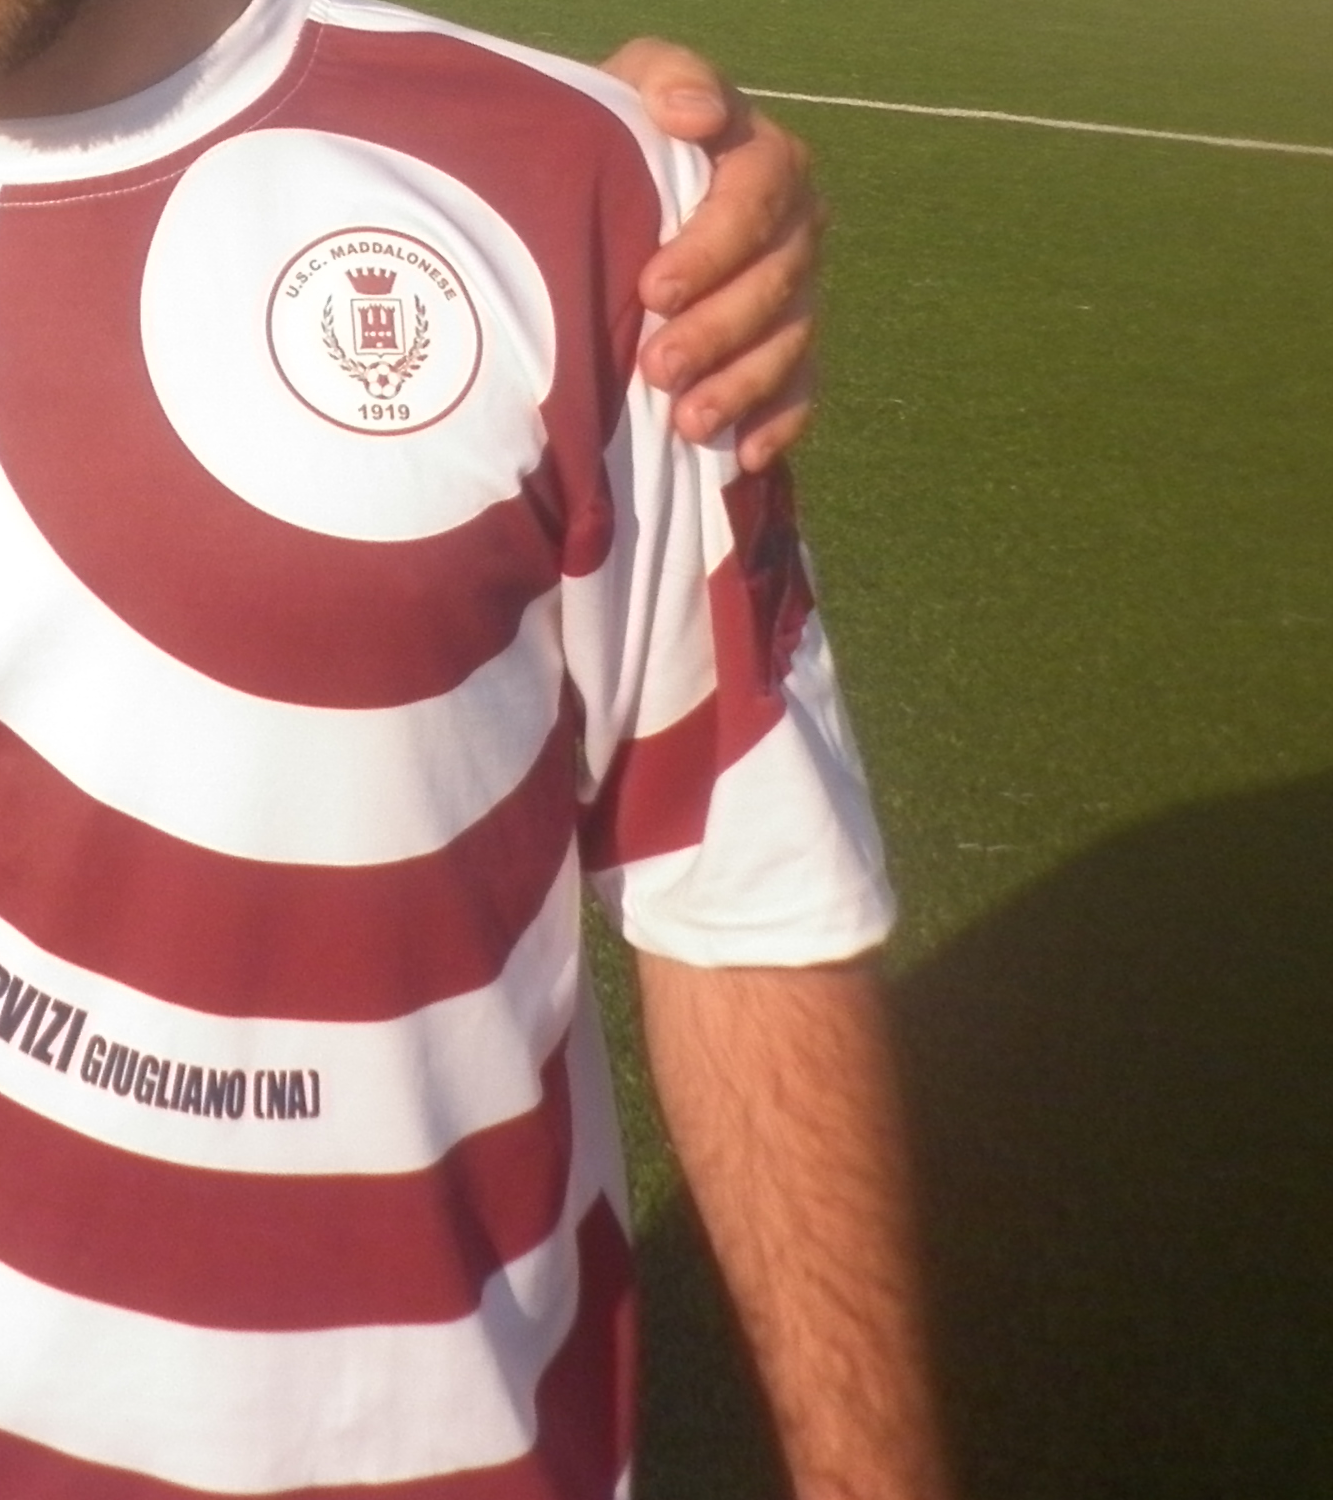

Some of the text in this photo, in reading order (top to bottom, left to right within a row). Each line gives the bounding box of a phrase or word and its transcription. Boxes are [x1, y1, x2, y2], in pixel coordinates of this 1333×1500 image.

[285, 241, 457, 301] U.S.C. MADDALONESE
[357, 403, 411, 421] 1919
[80, 1034, 247, 1120] GIUGLIANO
